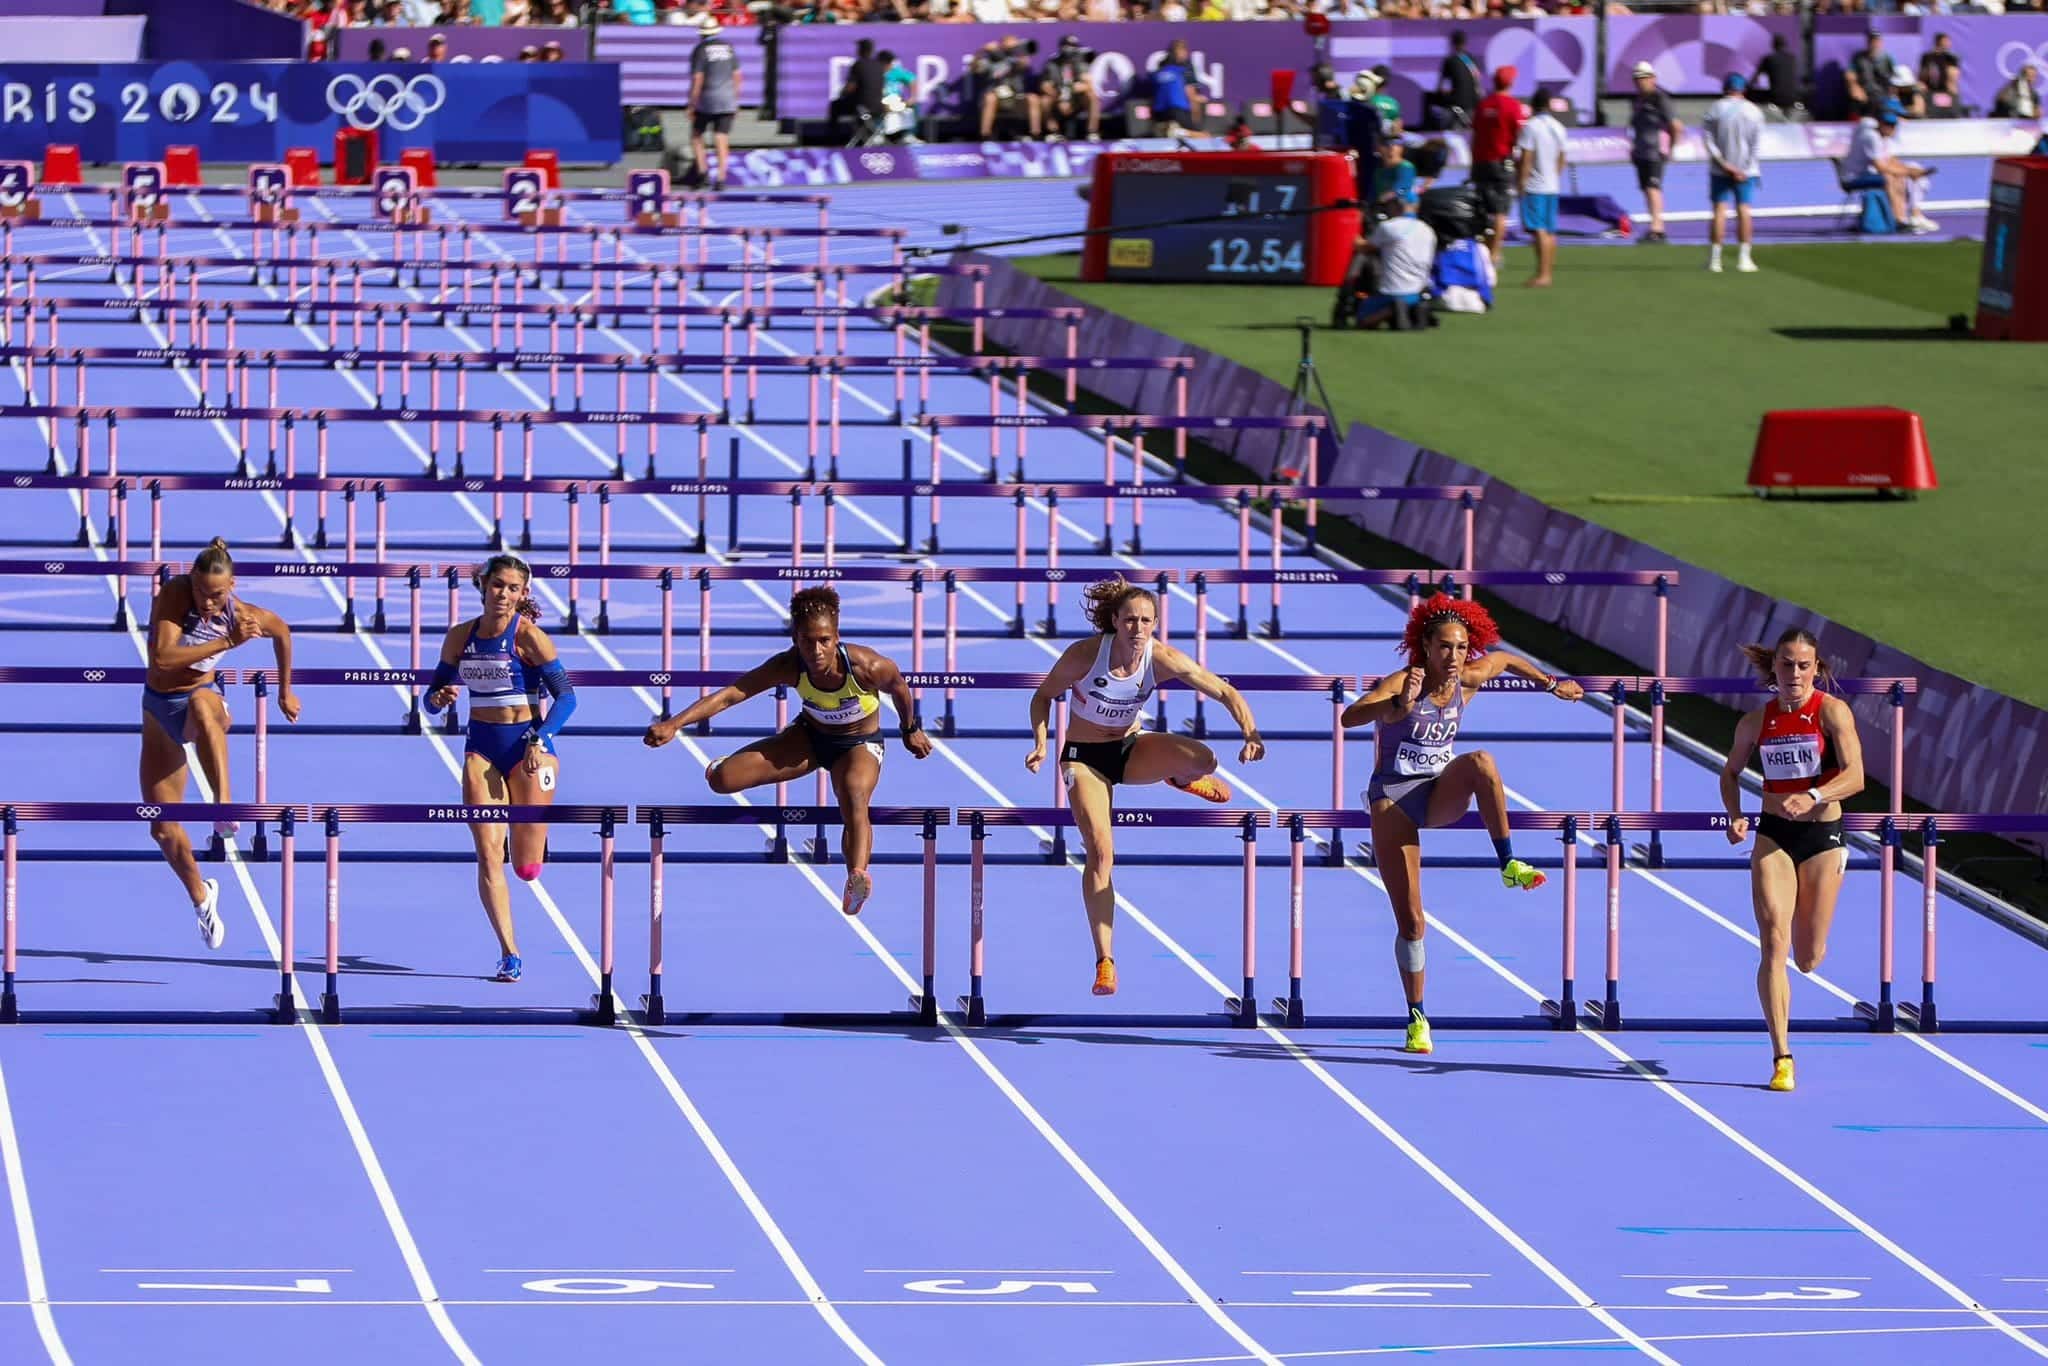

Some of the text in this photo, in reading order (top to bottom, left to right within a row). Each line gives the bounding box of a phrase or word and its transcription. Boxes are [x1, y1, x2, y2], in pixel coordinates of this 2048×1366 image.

[121, 82, 278, 122] 2024
[511, 180, 540, 213] 2
[1206, 238, 1304, 272] 12.54
[224, 479, 282, 488] PARIS 2024
[274, 565, 338, 574] PARIS 2024
[778, 569, 843, 578] PARIS 2024
[344, 672, 416, 681] PARIS 2024
[905, 675, 975, 684] PARIS 2024
[1503, 679, 1536, 689] 2024
[1411, 721, 1457, 741] USA
[1766, 749, 1812, 766] KAELIN
[428, 809, 509, 818] PARIS 2024
[1117, 813, 1153, 823] 2024
